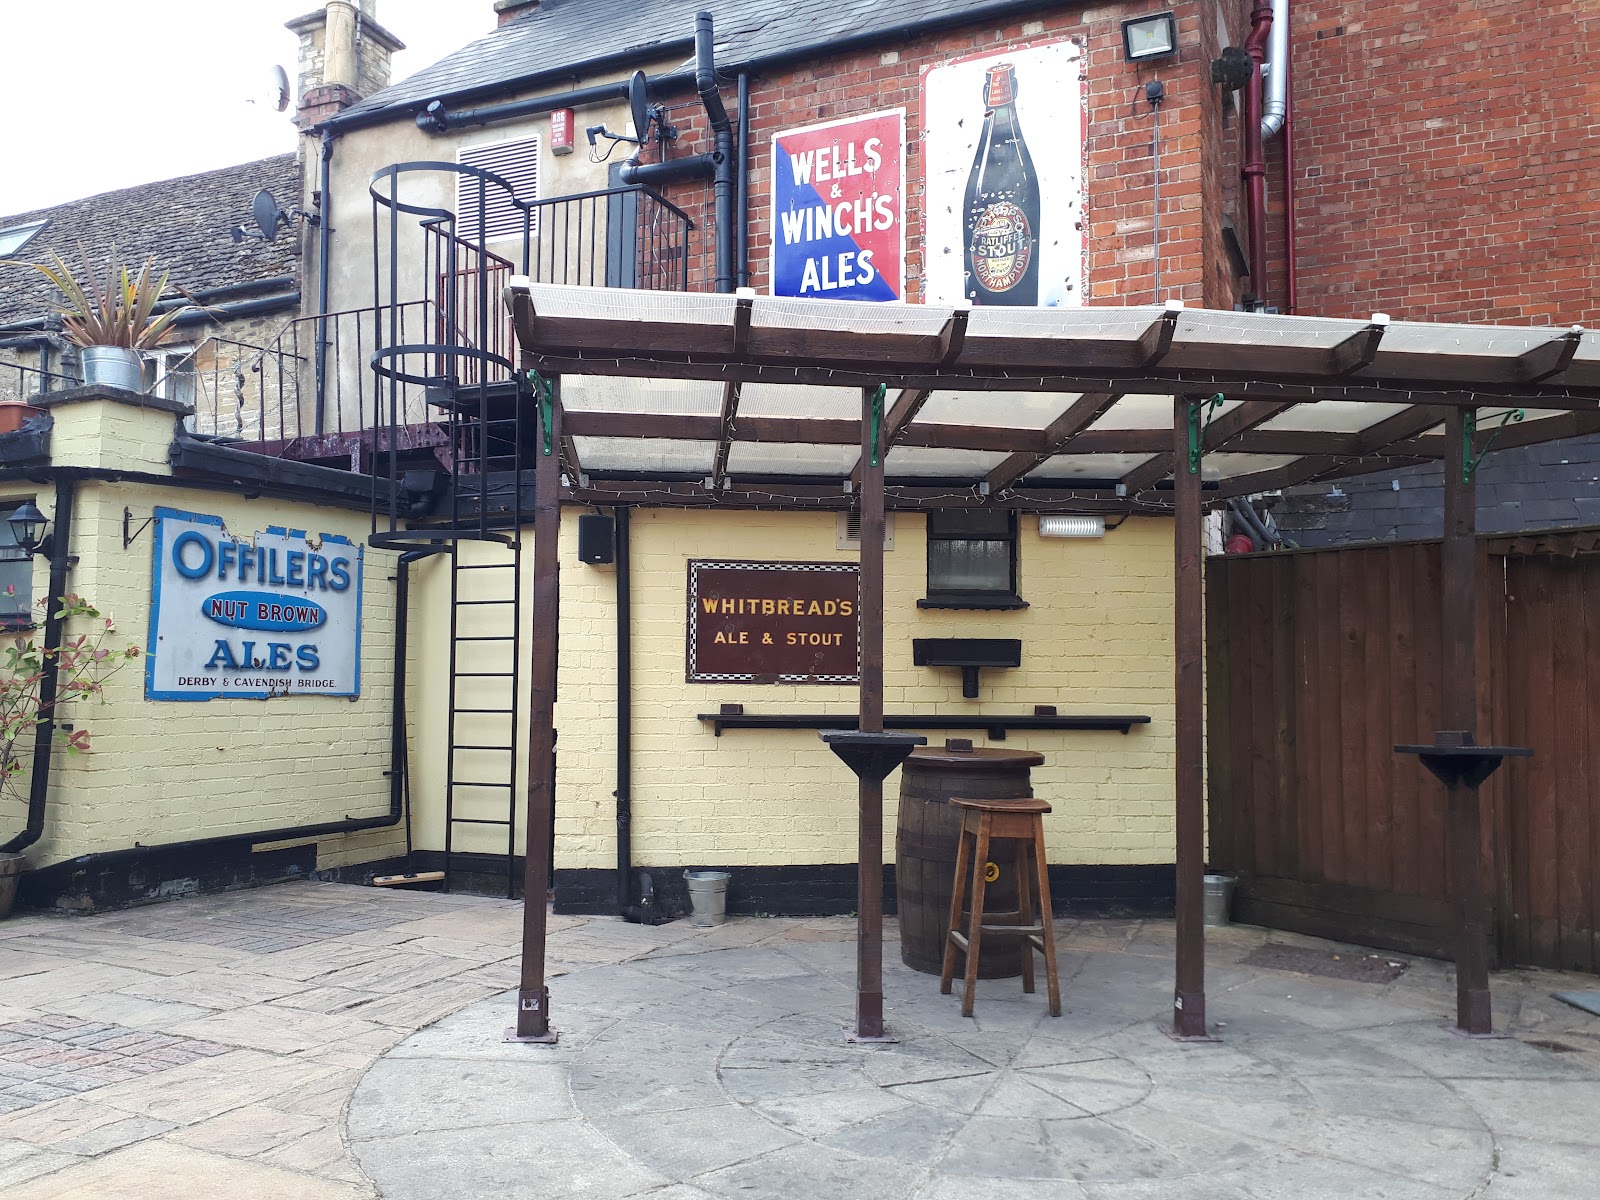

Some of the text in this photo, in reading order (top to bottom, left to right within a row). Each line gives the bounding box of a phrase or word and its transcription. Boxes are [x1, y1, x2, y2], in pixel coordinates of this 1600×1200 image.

[790, 138, 881, 186] WELLS
[830, 184, 842, 198] &
[781, 192, 894, 245] WINCH'S
[800, 250, 875, 294] ALES
[976, 254, 1026, 288] NORTHAMPTON
[173, 530, 350, 591] OFFILERS
[211, 599, 319, 624] NUT BROWN
[702, 598, 853, 616] WHITBREAD'S
[714, 631, 843, 646] ALE & STOUT
[204, 639, 320, 671] ALES
[178, 677, 218, 687] DERBY
[223, 677, 229, 687] &
[234, 678, 292, 688] CAVENDISH
